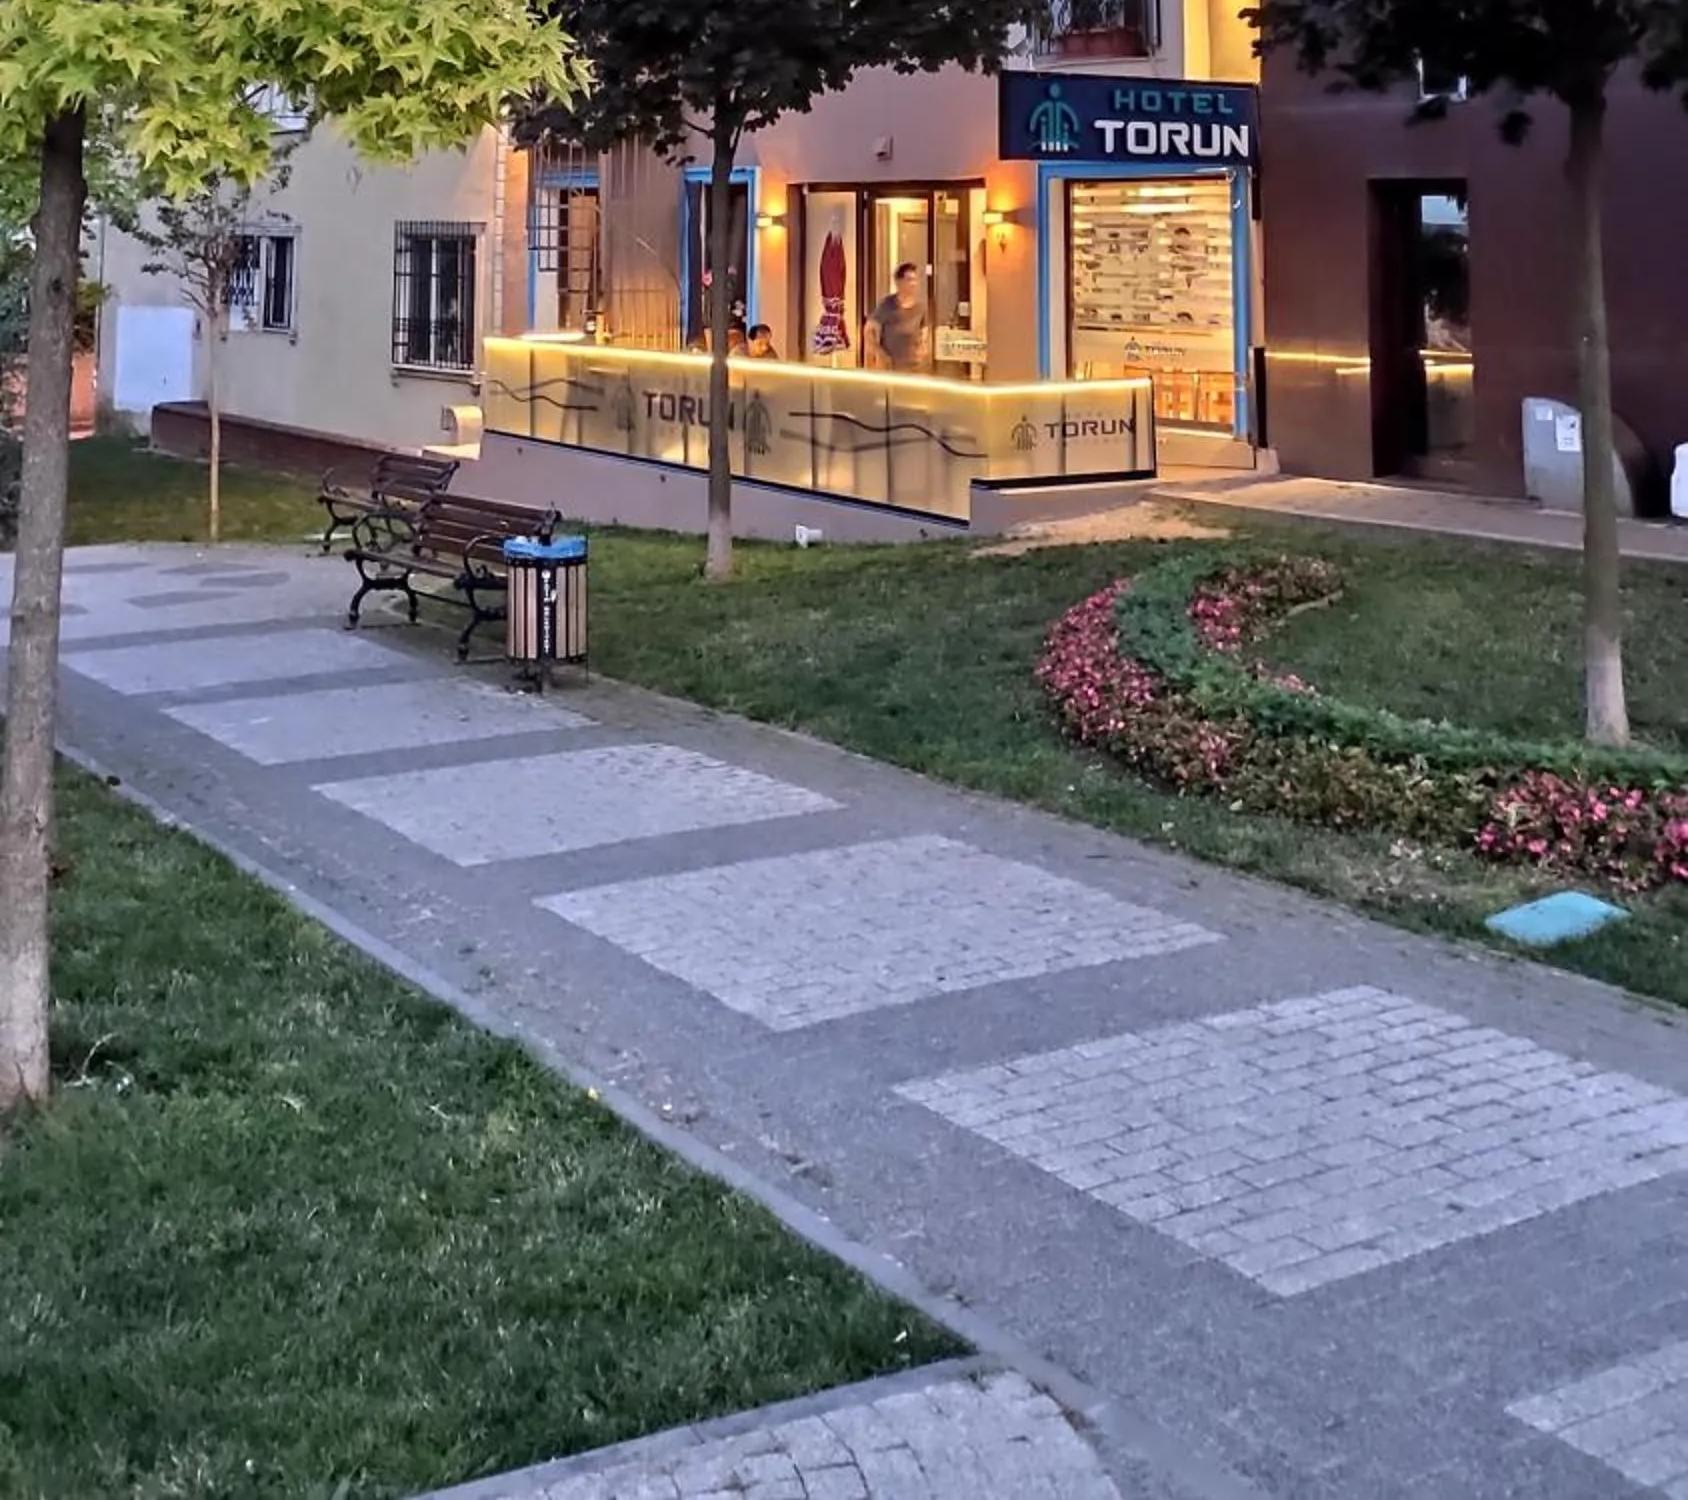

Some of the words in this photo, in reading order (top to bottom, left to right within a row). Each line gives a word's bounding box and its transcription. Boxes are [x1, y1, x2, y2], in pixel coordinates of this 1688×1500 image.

[1113, 88, 1234, 115] HOTEL
[1093, 119, 1249, 158] TORUN
[1043, 417, 1134, 439] TORUN
